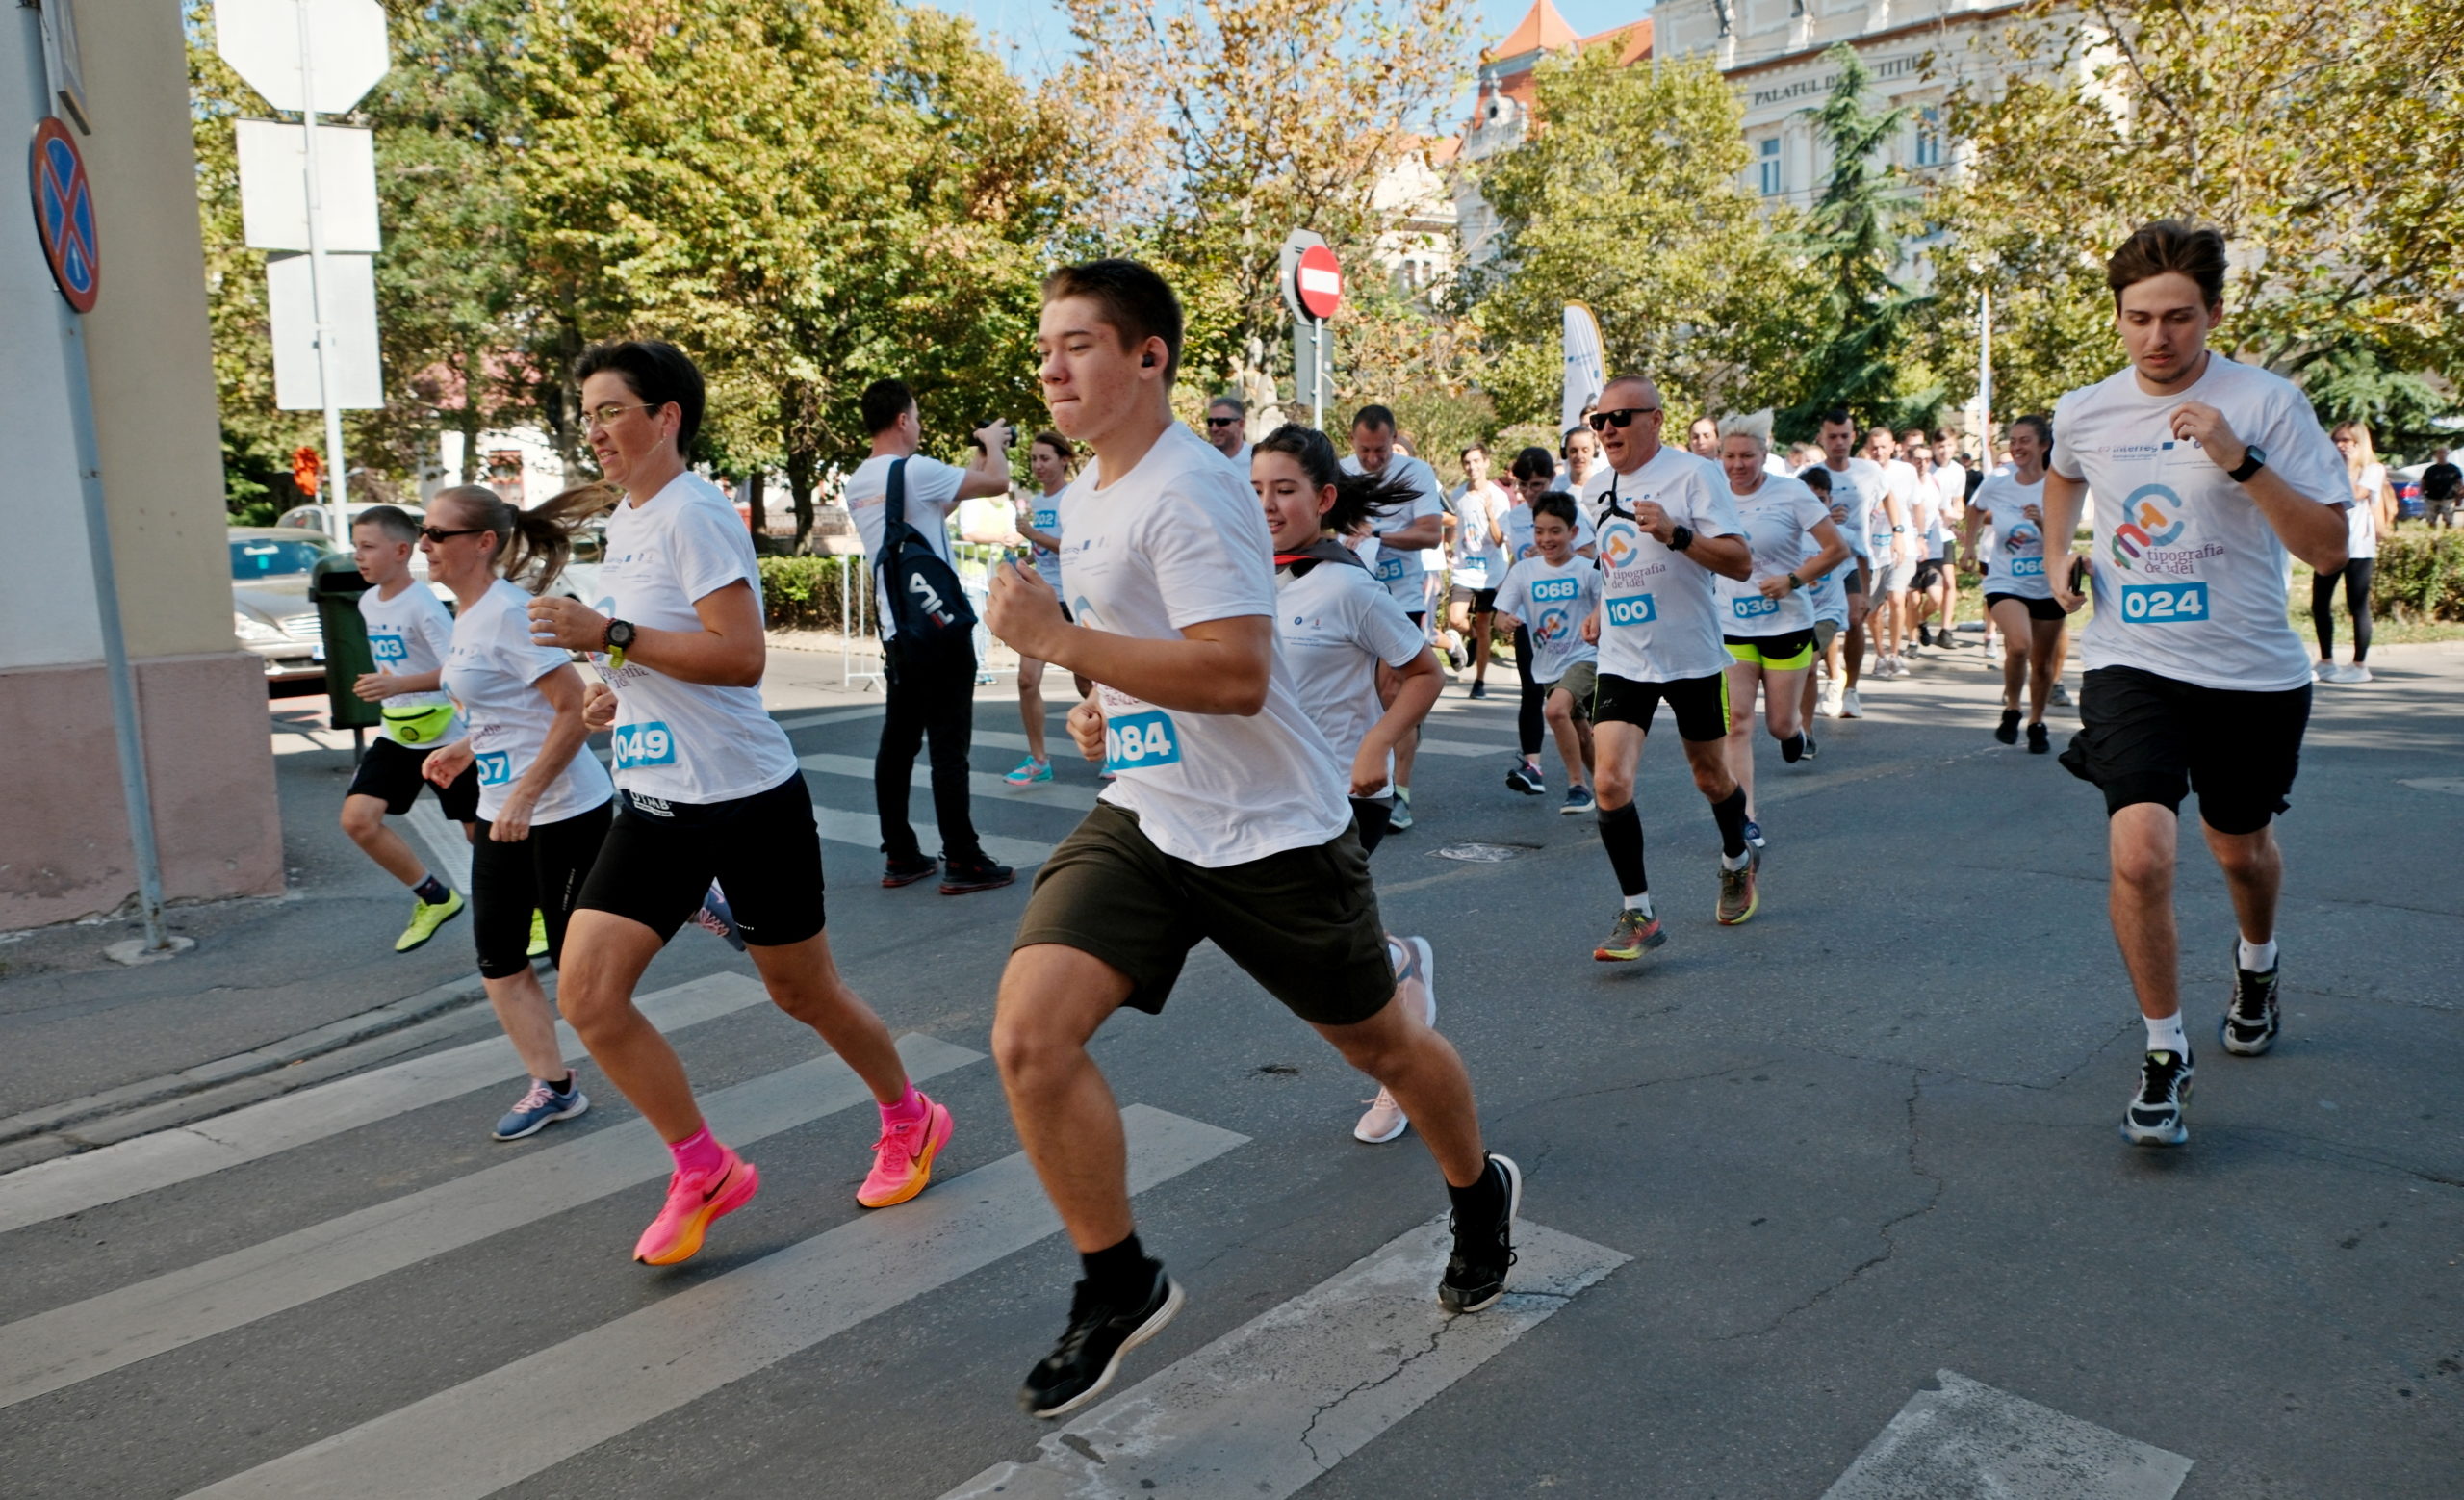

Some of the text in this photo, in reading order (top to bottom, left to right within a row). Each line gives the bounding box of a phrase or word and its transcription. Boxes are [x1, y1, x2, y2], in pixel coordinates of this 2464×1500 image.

[1754, 78, 1821, 106] PALATUL
[2146, 543, 2224, 565] tipografia
[1611, 576, 1645, 589] de idei
[1612, 562, 1666, 581] tipografia
[909, 572, 955, 629] FILA
[1534, 582, 1575, 599] 068
[1610, 600, 1649, 622] 100
[1735, 599, 1776, 616] 036
[2125, 590, 2203, 618] 024
[616, 729, 669, 763] 049
[1105, 721, 1172, 763] 084
